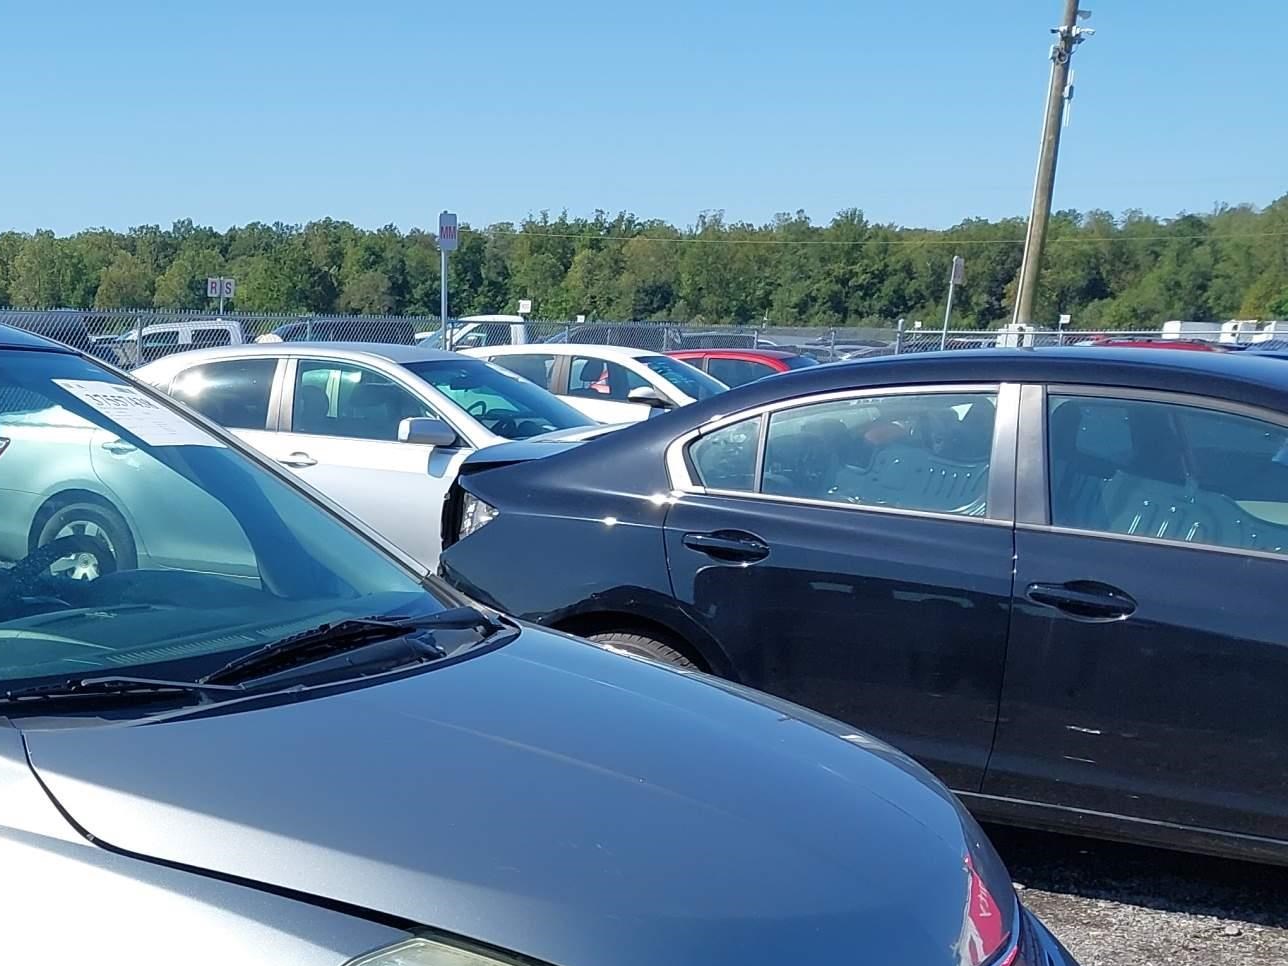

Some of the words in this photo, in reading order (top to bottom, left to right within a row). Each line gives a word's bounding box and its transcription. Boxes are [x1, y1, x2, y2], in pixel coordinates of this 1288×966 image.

[440, 225, 457, 240] MM
[210, 281, 218, 295] R
[224, 281, 233, 295] S
